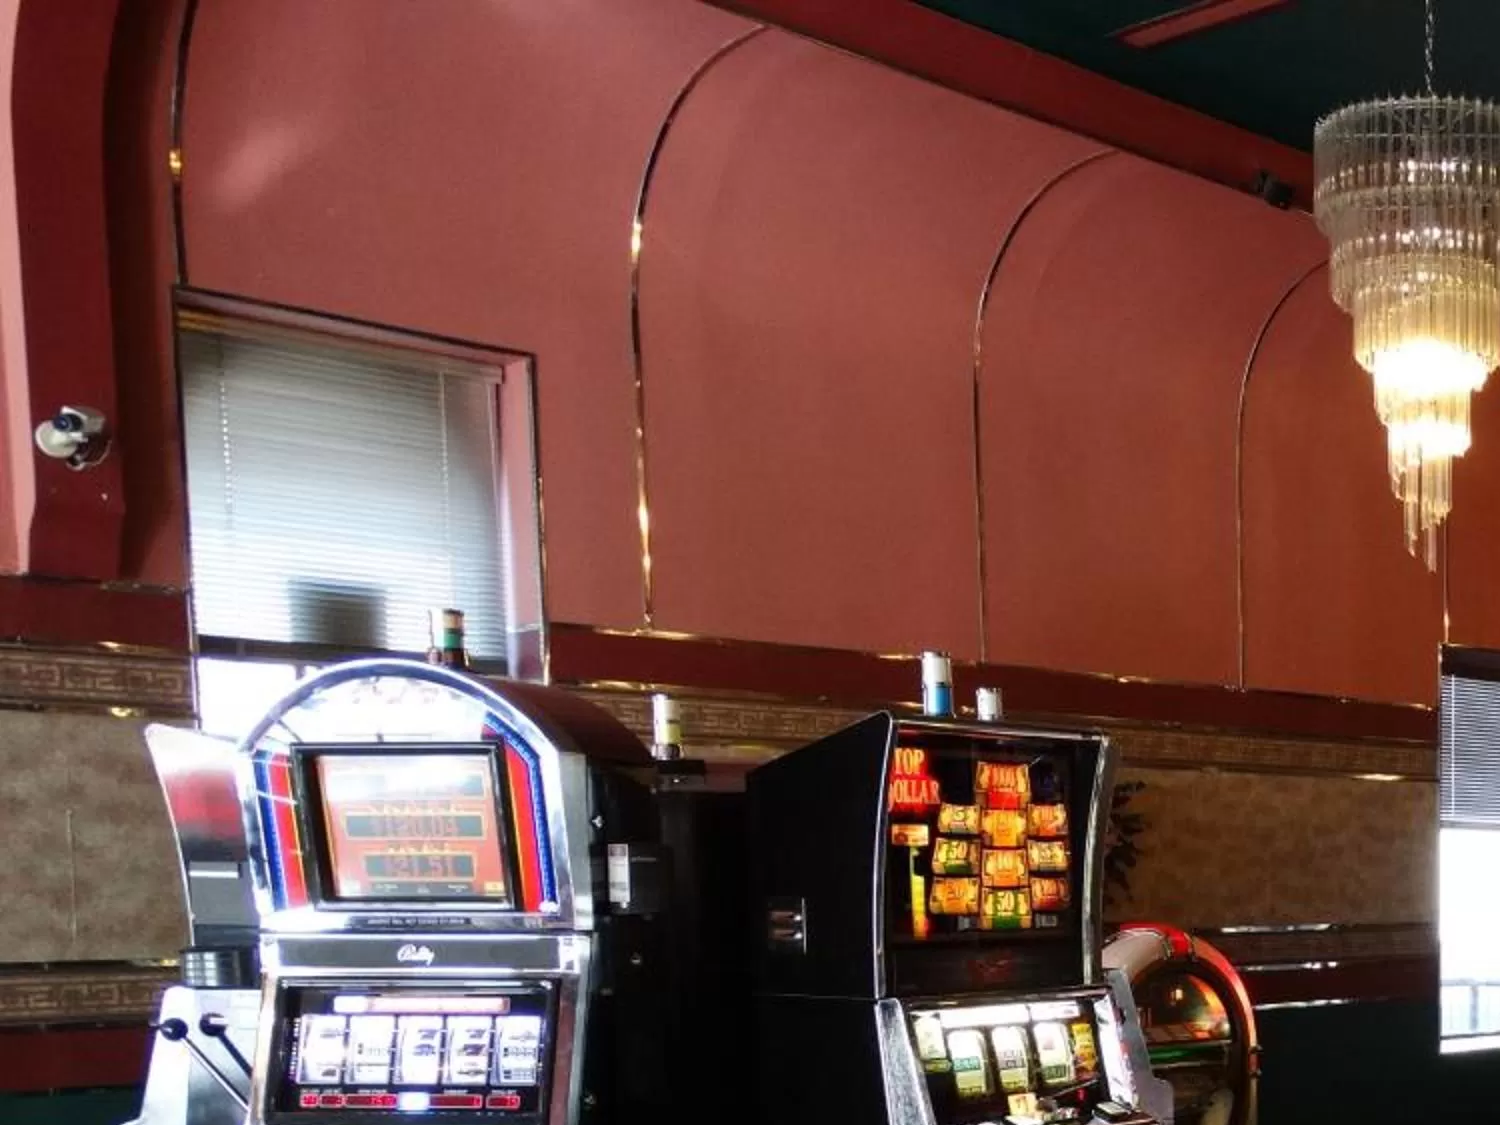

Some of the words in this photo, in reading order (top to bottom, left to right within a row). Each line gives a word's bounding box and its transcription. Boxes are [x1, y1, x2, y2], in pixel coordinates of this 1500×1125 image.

[894, 747, 925, 775] TOP
[996, 891, 1015, 913] 50
[397, 943, 435, 966] Bally
